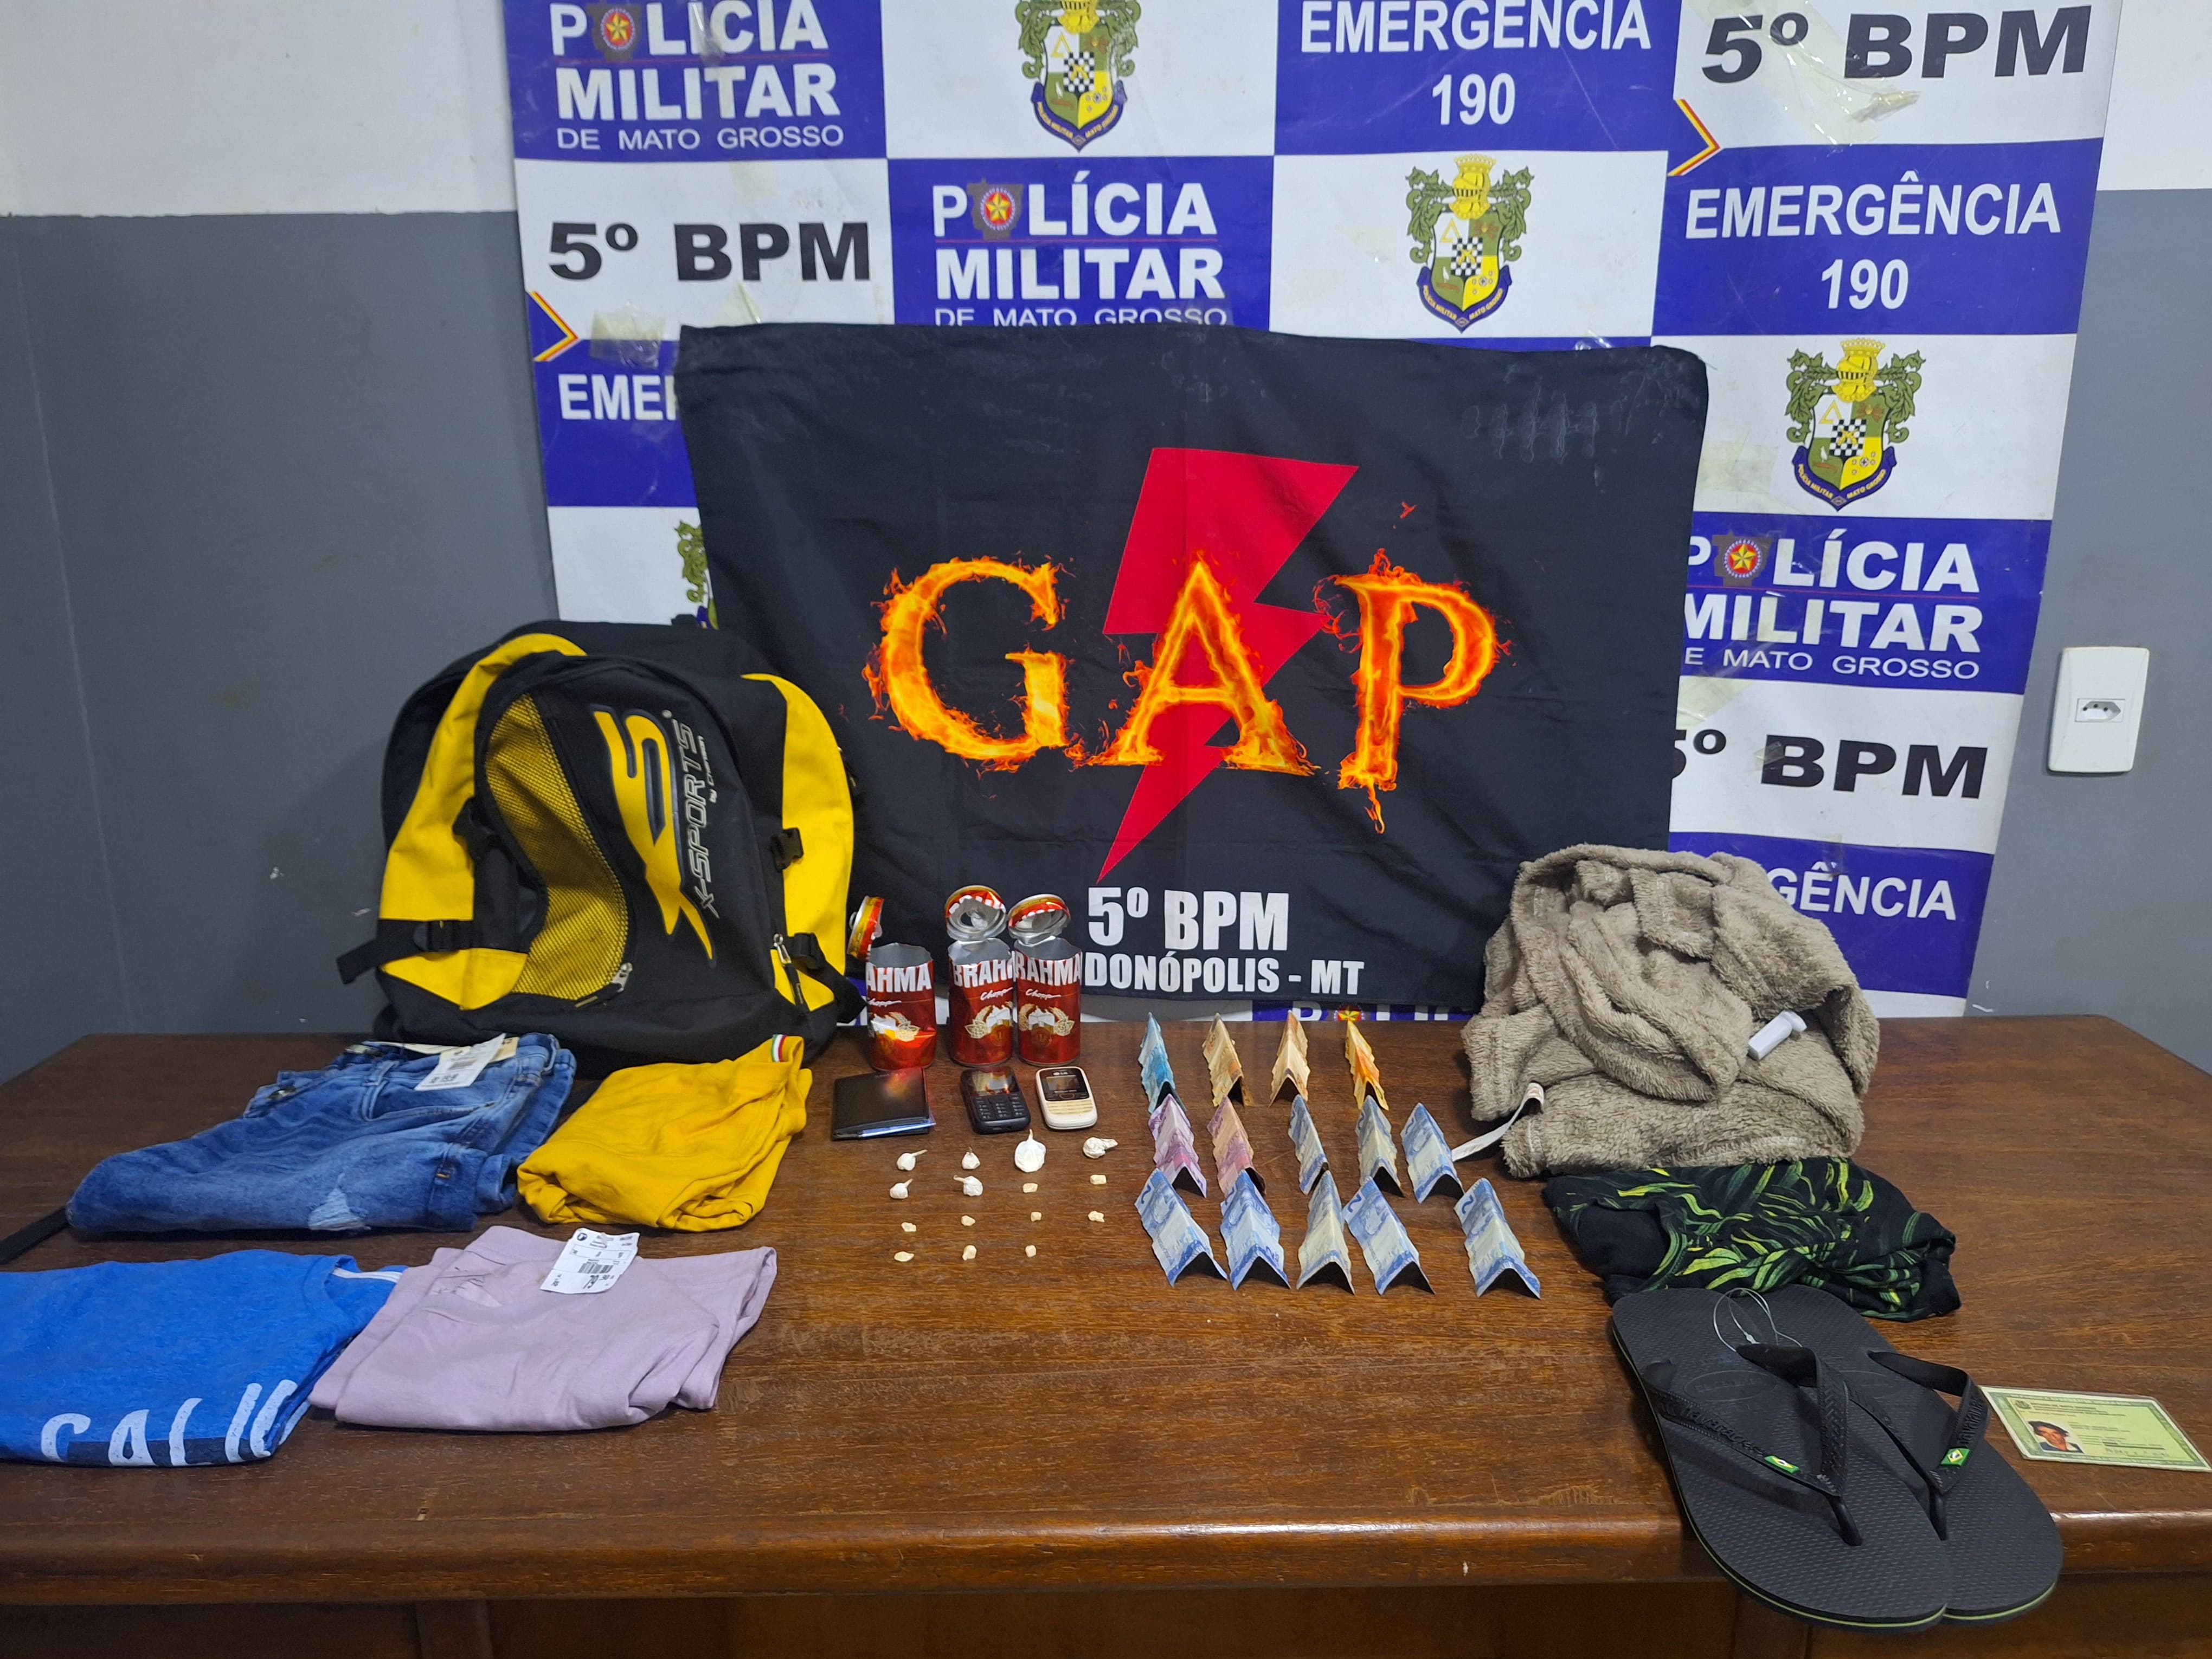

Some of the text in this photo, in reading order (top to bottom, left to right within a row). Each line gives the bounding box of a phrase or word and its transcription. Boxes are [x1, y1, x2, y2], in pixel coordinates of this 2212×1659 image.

[1844, 5, 2091, 78] BPM
[556, 63, 840, 120] MILITAR
[1432, 73, 1515, 125] 190
[557, 125, 844, 150] DE MATO GROSSO
[1686, 171, 2061, 239] EMERGÊNCIA
[673, 222, 871, 281] BPM
[935, 248, 1225, 300] MILITAR
[1822, 259, 1908, 310] 190
[993, 308, 1077, 326] MATO
[1684, 593, 1983, 653] MILITAR
[867, 551, 1513, 802] GAP
[1684, 647, 1980, 679] E MATO GROSSO
[1761, 735, 1988, 799] BPM
[1769, 861, 1956, 921] GÊNCIA
[1164, 889, 1289, 951] BPM
[866, 962, 933, 993] AHMA
[1085, 951, 1365, 995] DONÓPOLIS - MT
